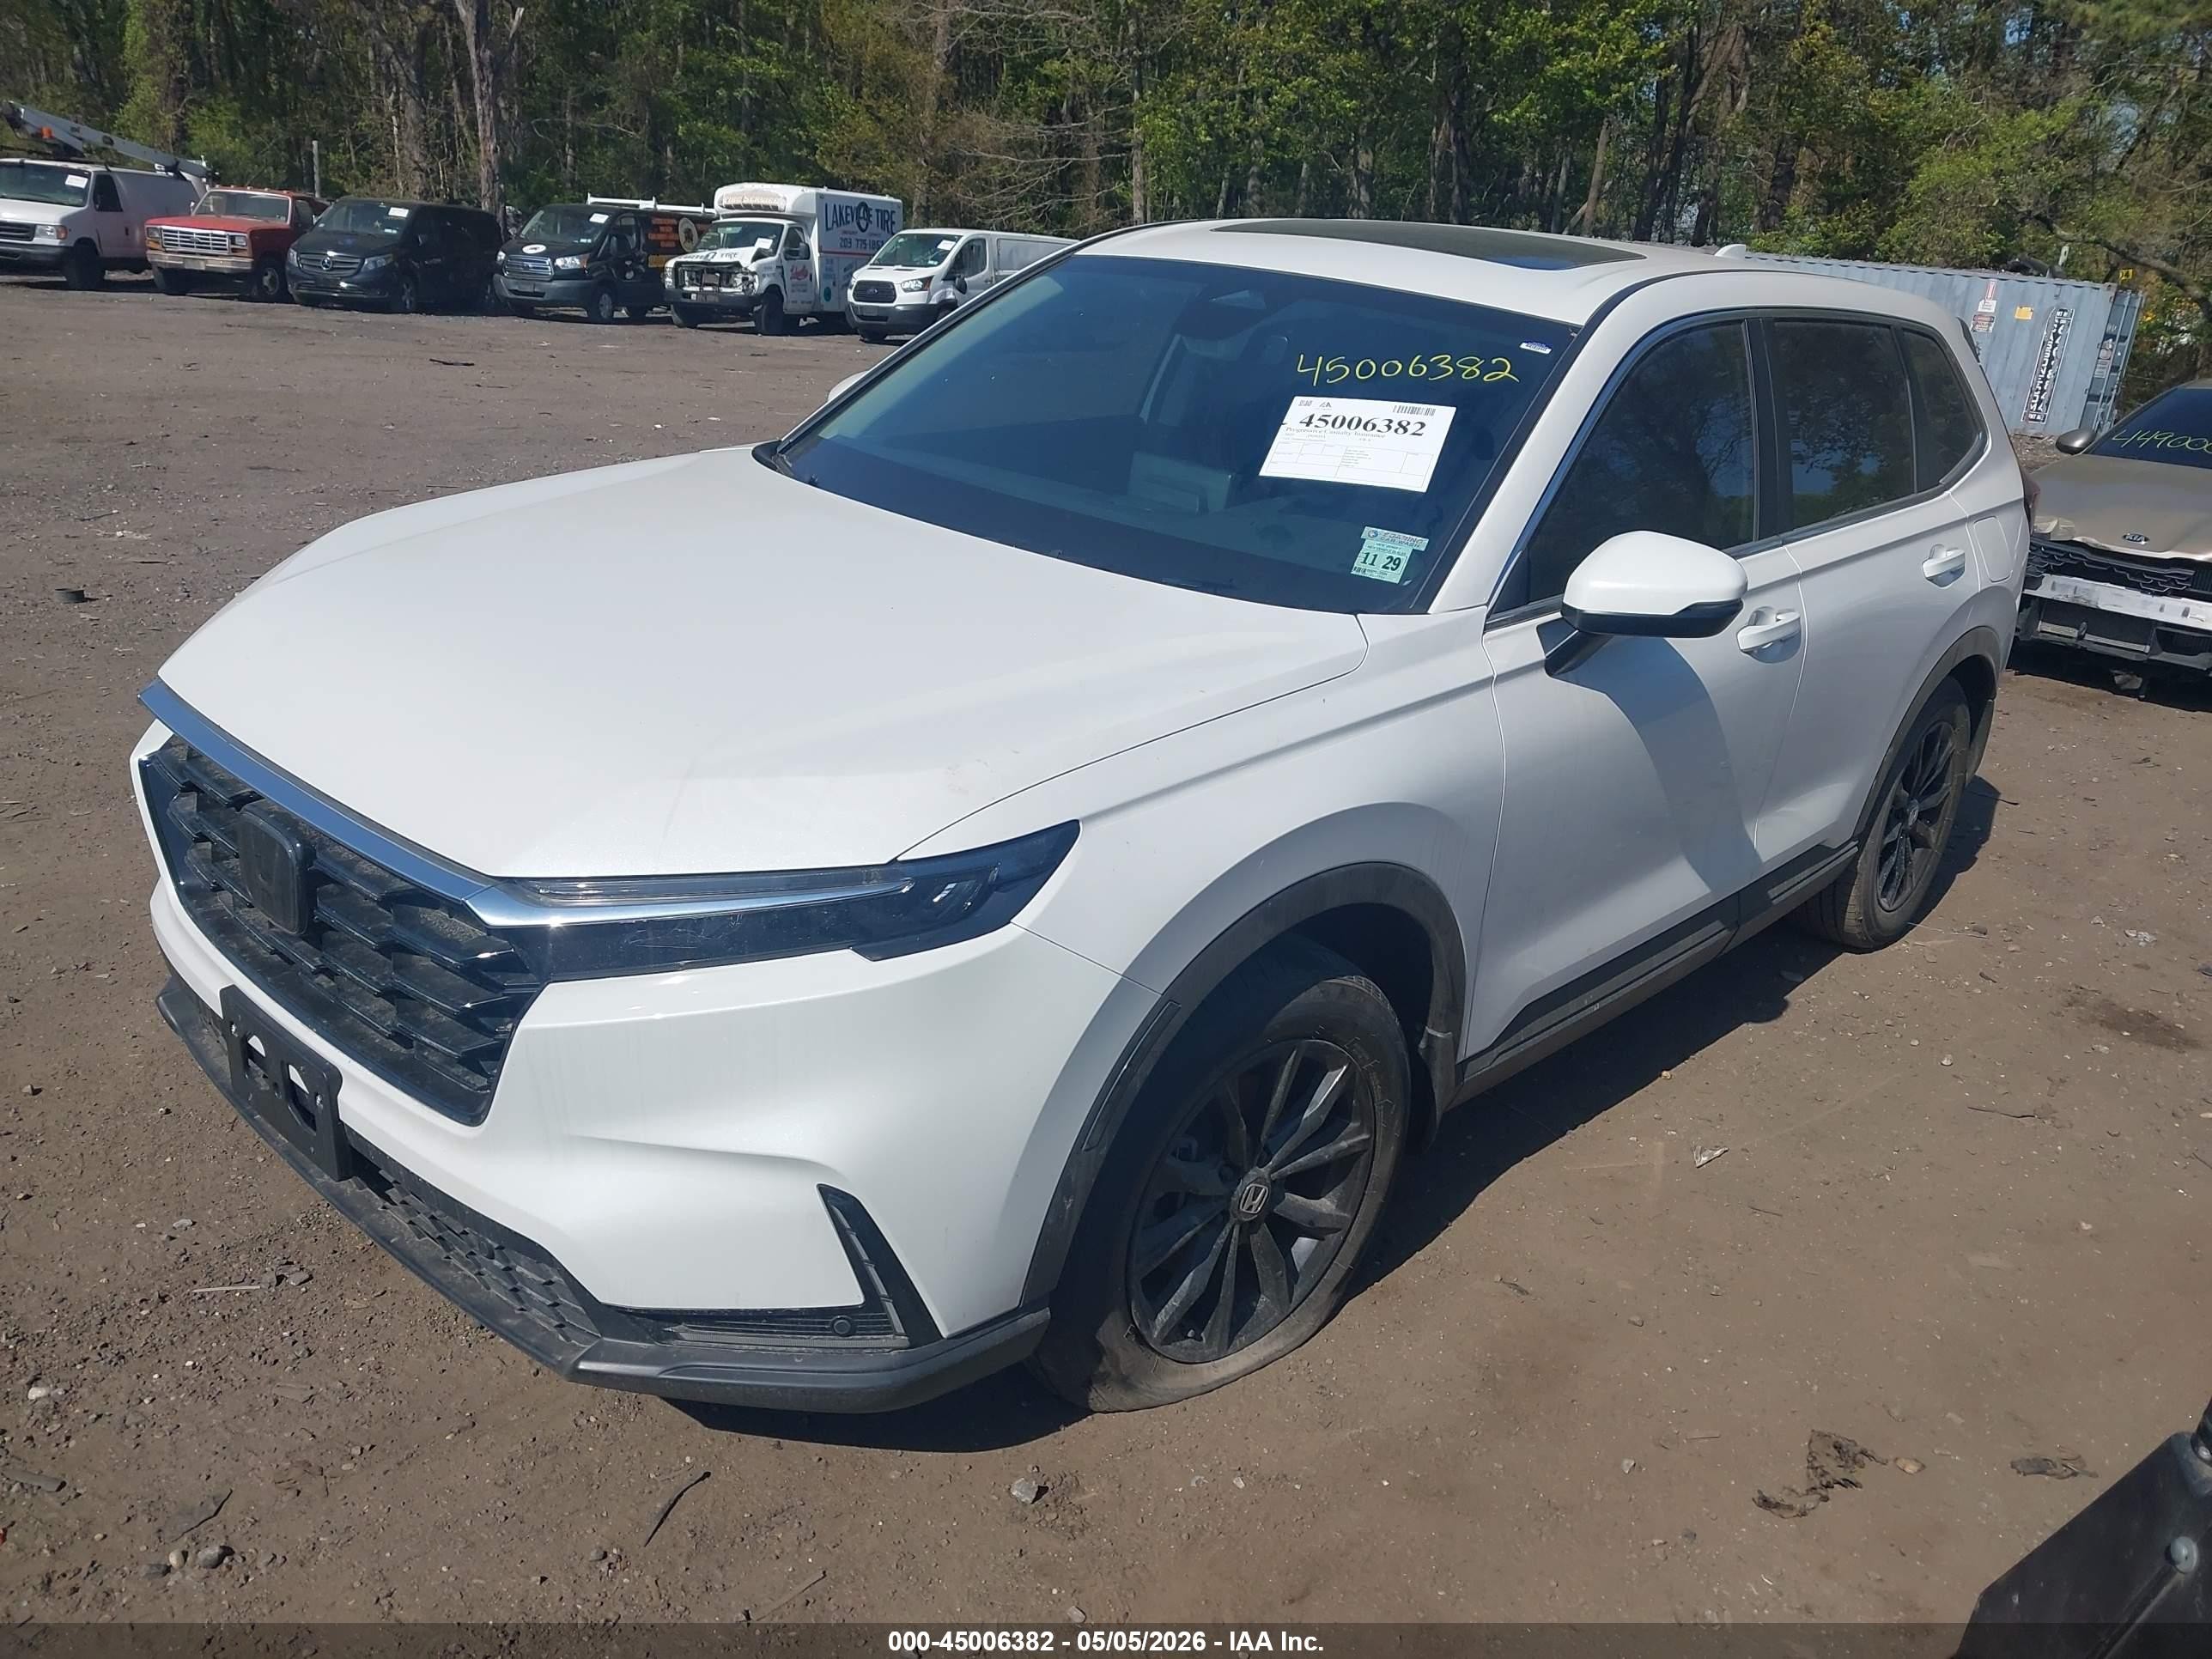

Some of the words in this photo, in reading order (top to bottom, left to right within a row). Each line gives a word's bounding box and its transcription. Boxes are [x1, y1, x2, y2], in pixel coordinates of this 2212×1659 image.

[875, 209, 896, 235] TIRE
[839, 238, 852, 248] 203
[1297, 353, 1519, 386] 45006382
[1299, 413, 1427, 436] 45006382
[2125, 533, 2146, 543] KIA
[1360, 551, 1378, 567] 11
[1382, 555, 1402, 571] 29
